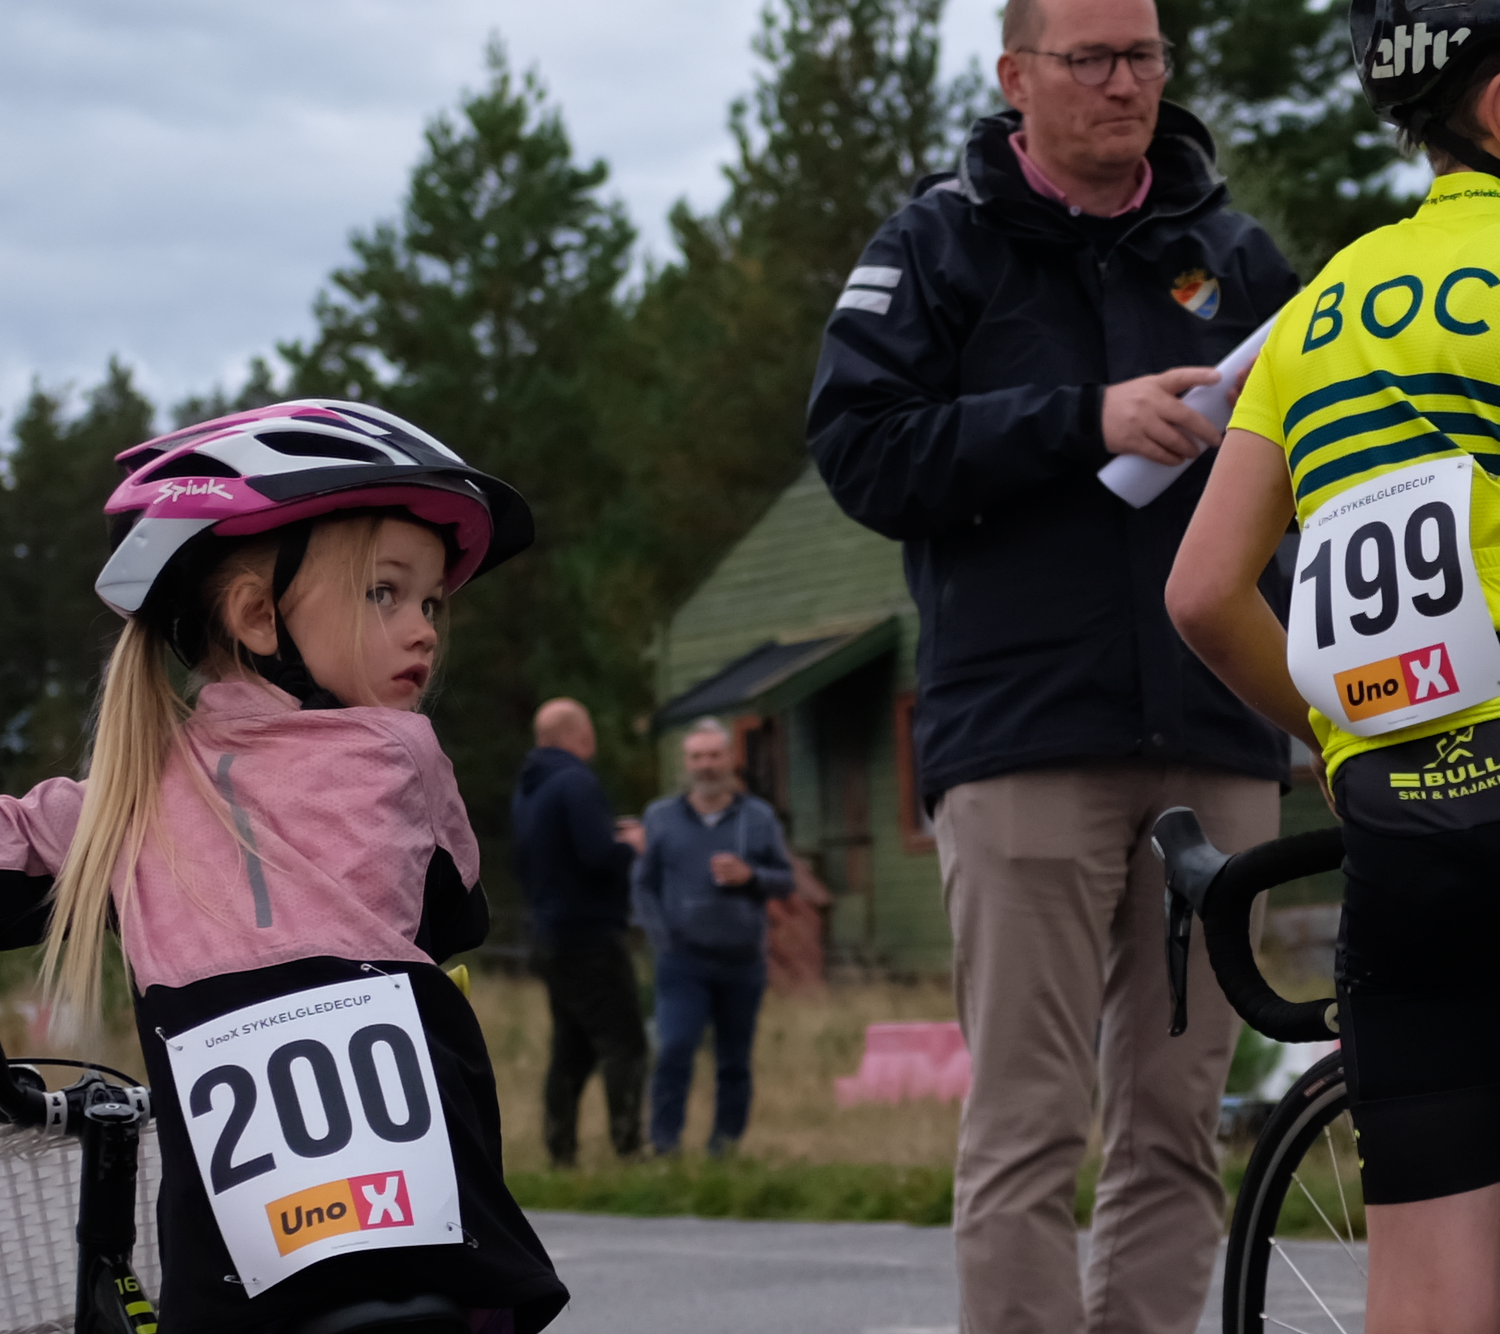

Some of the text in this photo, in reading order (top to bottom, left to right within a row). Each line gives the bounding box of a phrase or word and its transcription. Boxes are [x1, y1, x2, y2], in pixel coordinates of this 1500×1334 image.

[1302, 267, 1500, 355] BOC
[153, 479, 234, 505] Spiuk
[1300, 501, 1463, 650] 199
[1346, 648, 1451, 707] Uno X
[1398, 790, 1427, 801] SKI
[1431, 790, 1444, 800] &
[205, 995, 372, 1049] UnoX SYKKELGLEDECUP
[190, 1024, 431, 1195] 200
[280, 1175, 405, 1235] Uno X
[115, 1276, 140, 1295] 16
